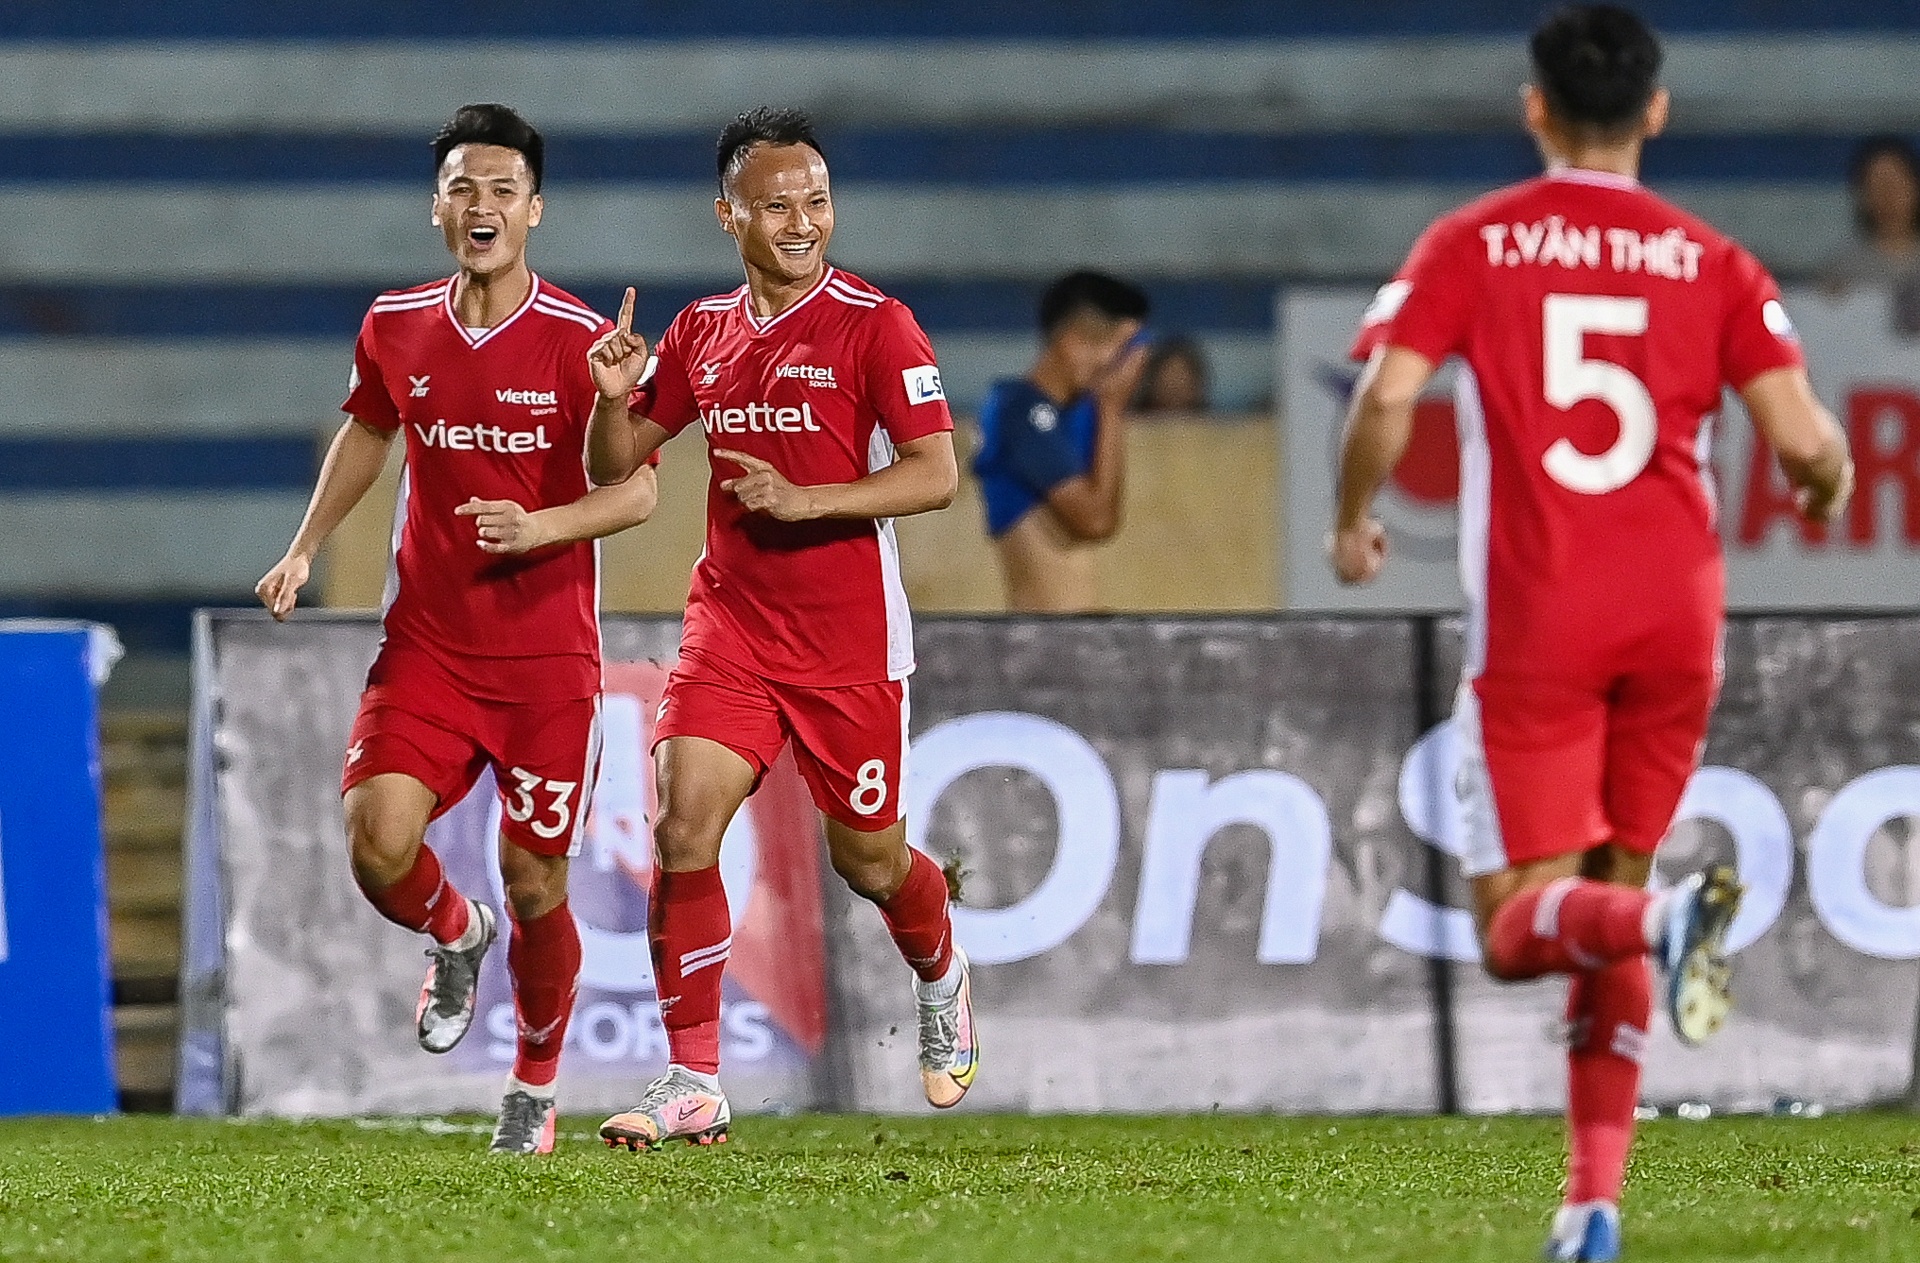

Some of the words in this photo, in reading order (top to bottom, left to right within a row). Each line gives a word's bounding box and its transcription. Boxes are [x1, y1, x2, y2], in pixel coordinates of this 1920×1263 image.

[775, 363, 836, 381] viettel
[495, 387, 558, 405] viettel
[1541, 291, 1658, 495] 5
[699, 401, 821, 434] viettel
[413, 418, 552, 454] viettel
[506, 766, 578, 839] 33
[849, 758, 888, 815] 8
